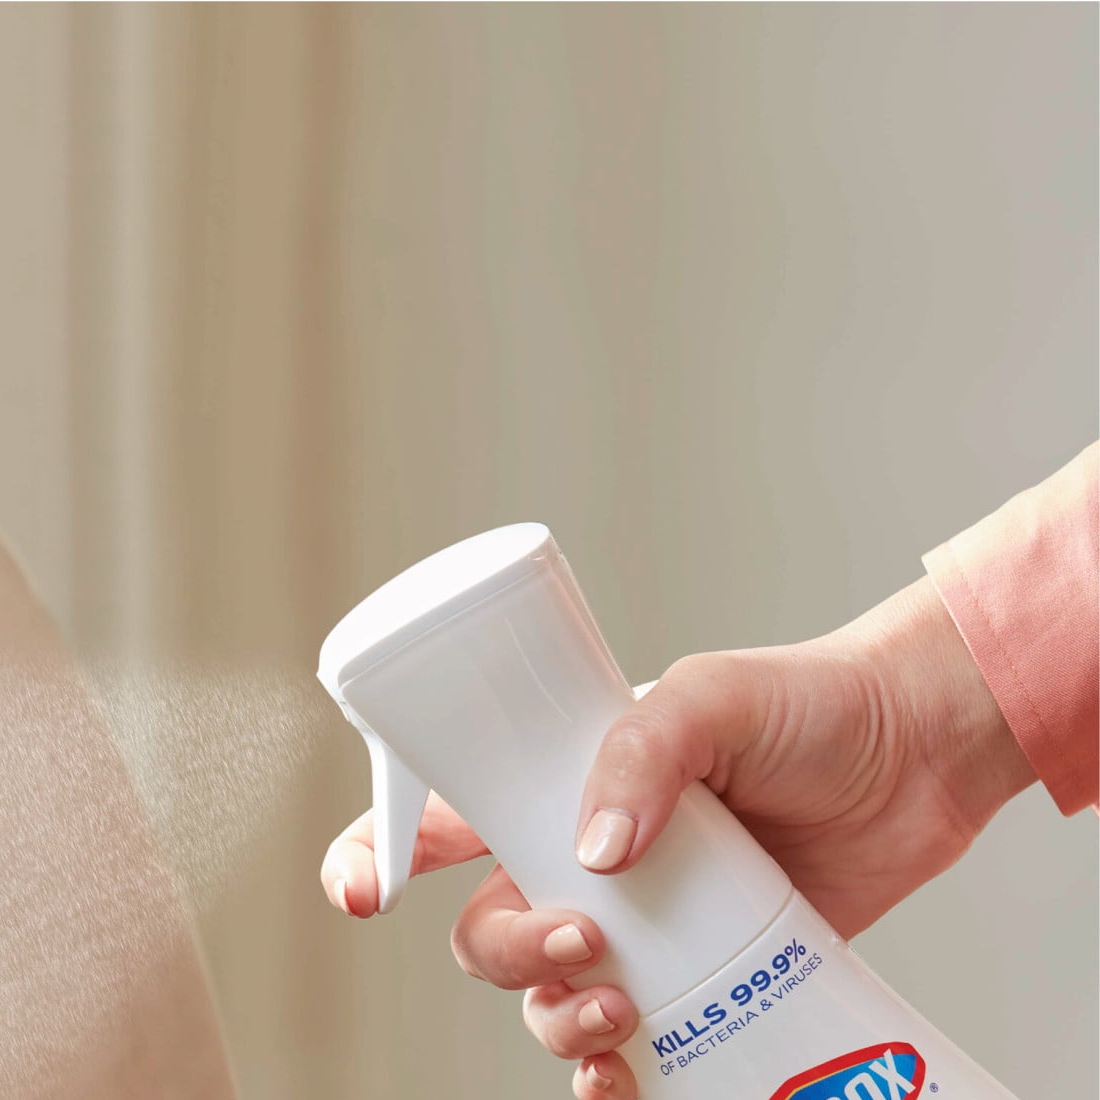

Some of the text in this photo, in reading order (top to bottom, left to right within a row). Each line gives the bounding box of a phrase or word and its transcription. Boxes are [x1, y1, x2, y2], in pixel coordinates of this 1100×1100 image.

[652, 938, 806, 1057] KILLS 99.9%
[660, 953, 822, 1075] OF BACTERIA & VIRUSES
